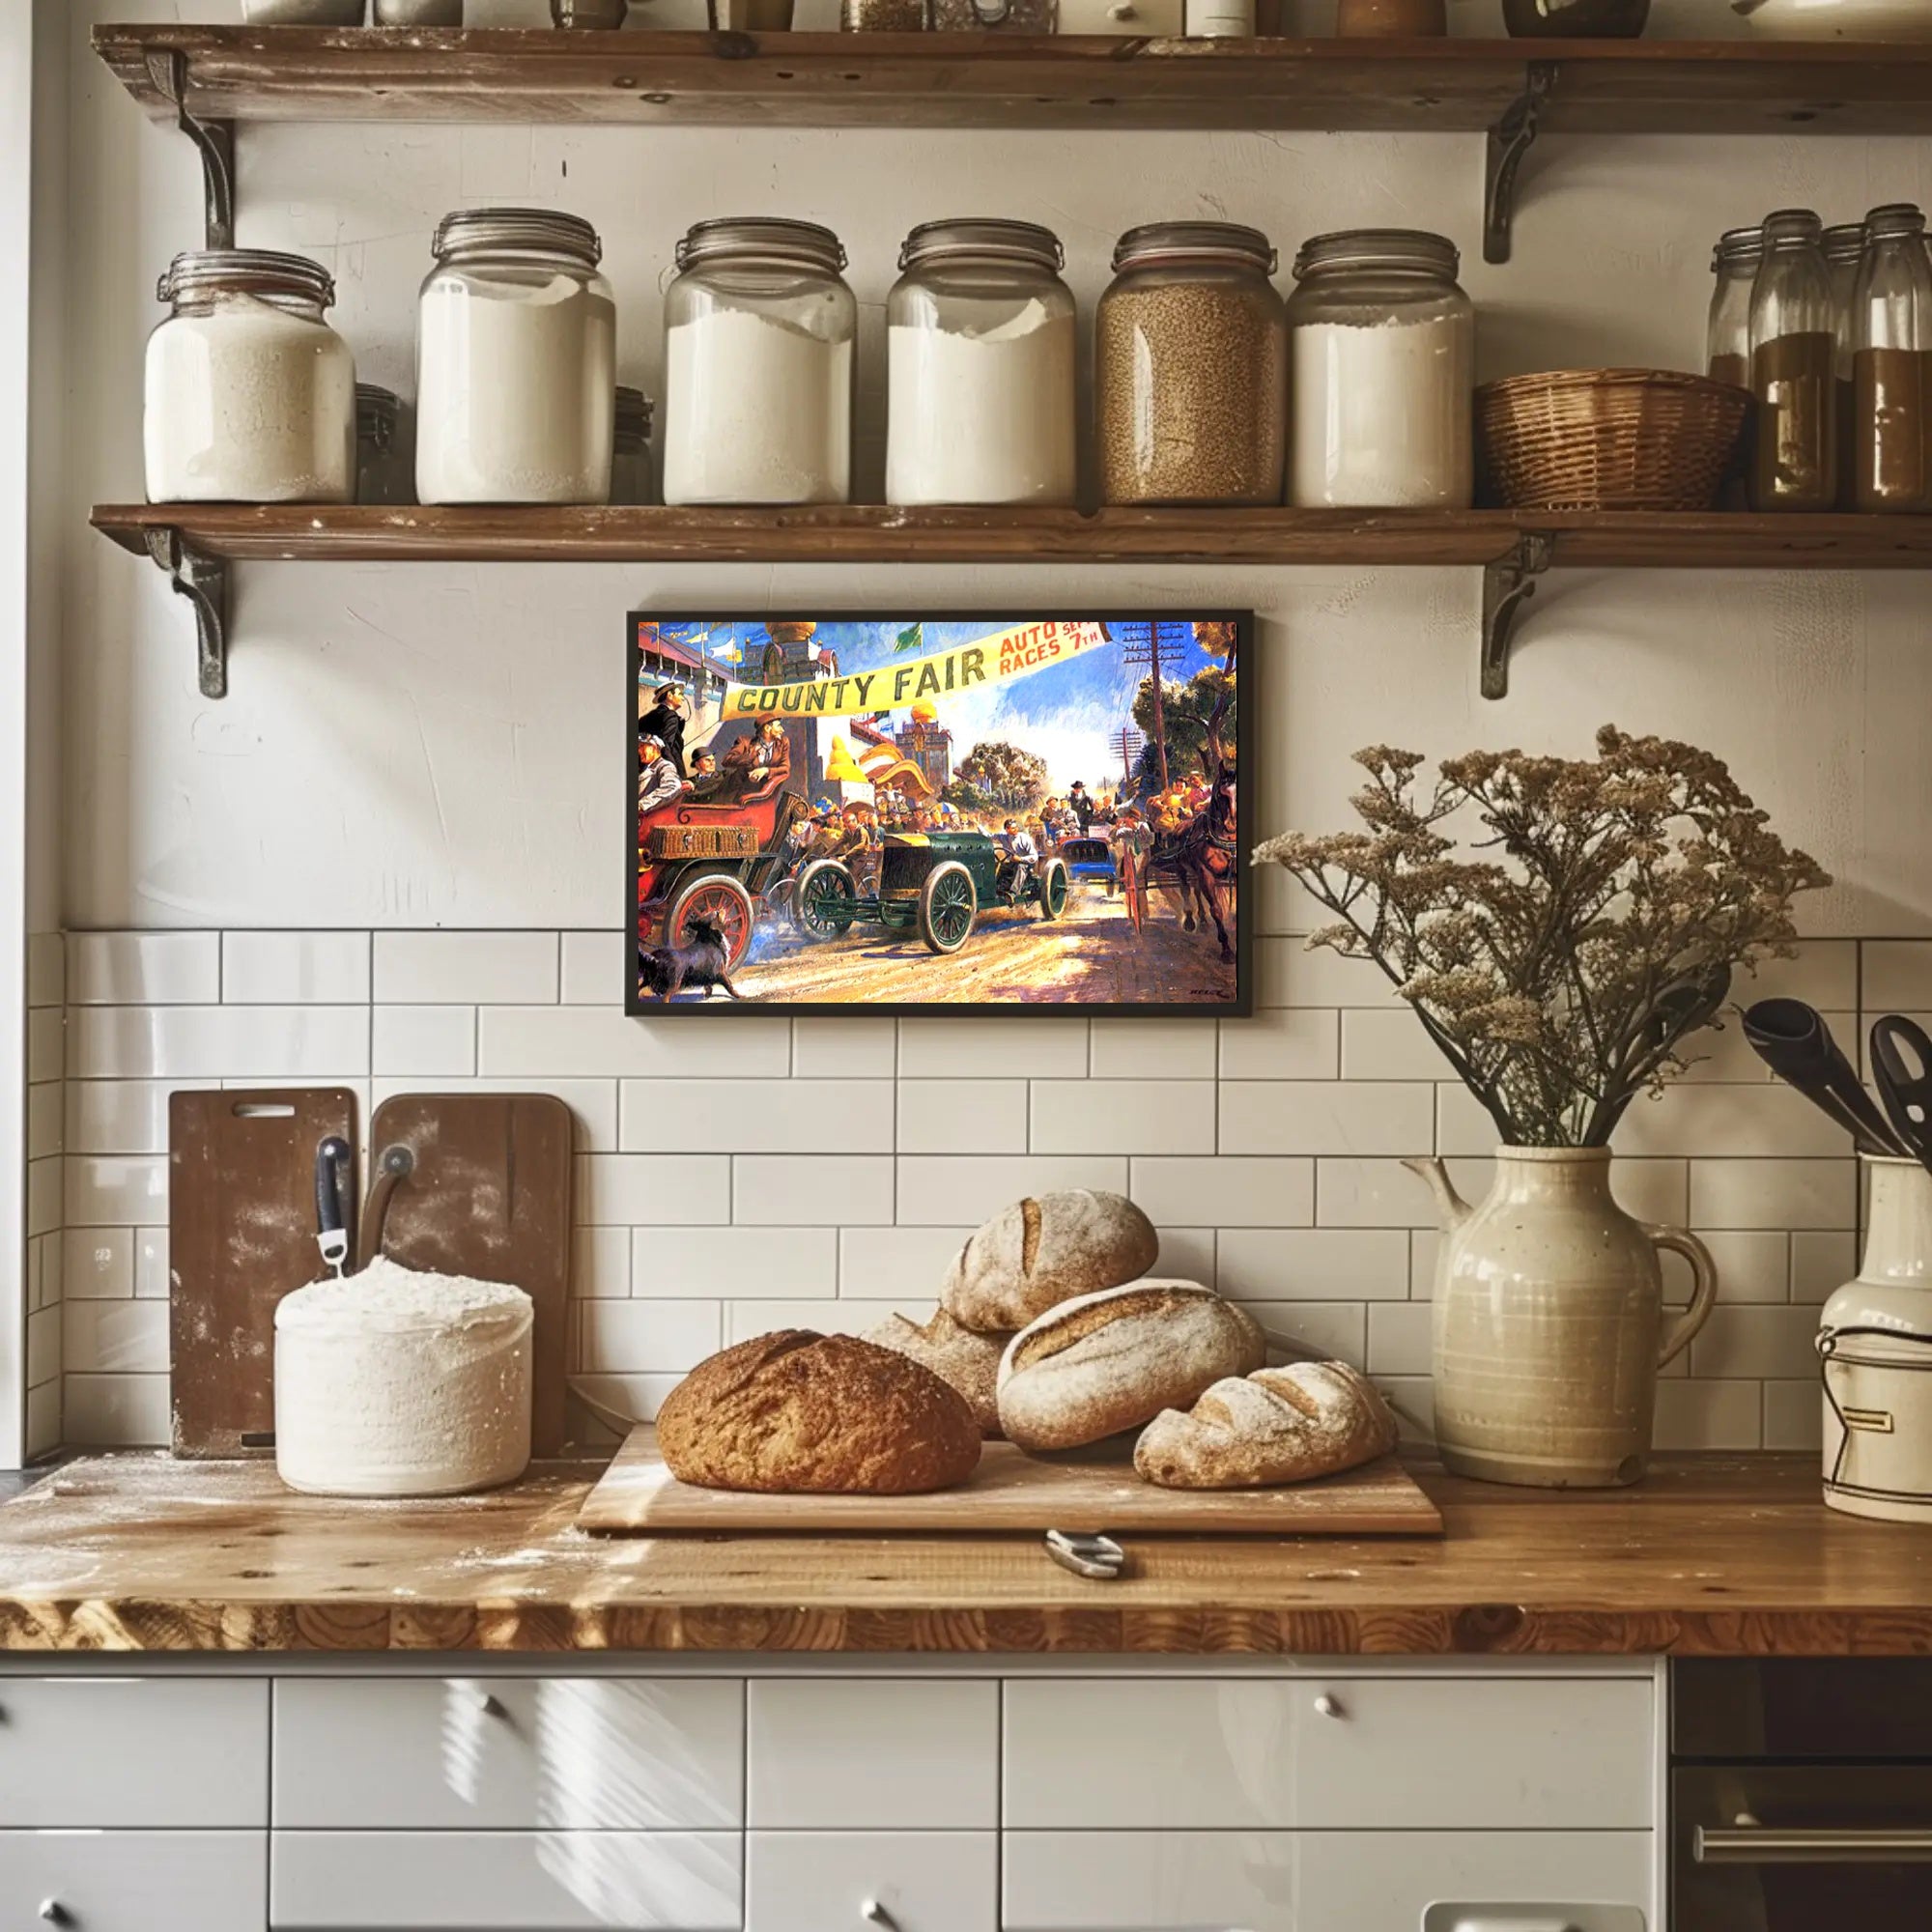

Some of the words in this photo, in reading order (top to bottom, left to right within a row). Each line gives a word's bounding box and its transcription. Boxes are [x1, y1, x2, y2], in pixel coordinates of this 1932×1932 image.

[999, 639, 1061, 675] RACES
[1069, 632, 1098, 650] 7TH
[1000, 621, 1057, 658] AUTO
[1063, 621, 1092, 636] SEP
[737, 675, 874, 712] COUNTY
[895, 648, 986, 701] FAIR
